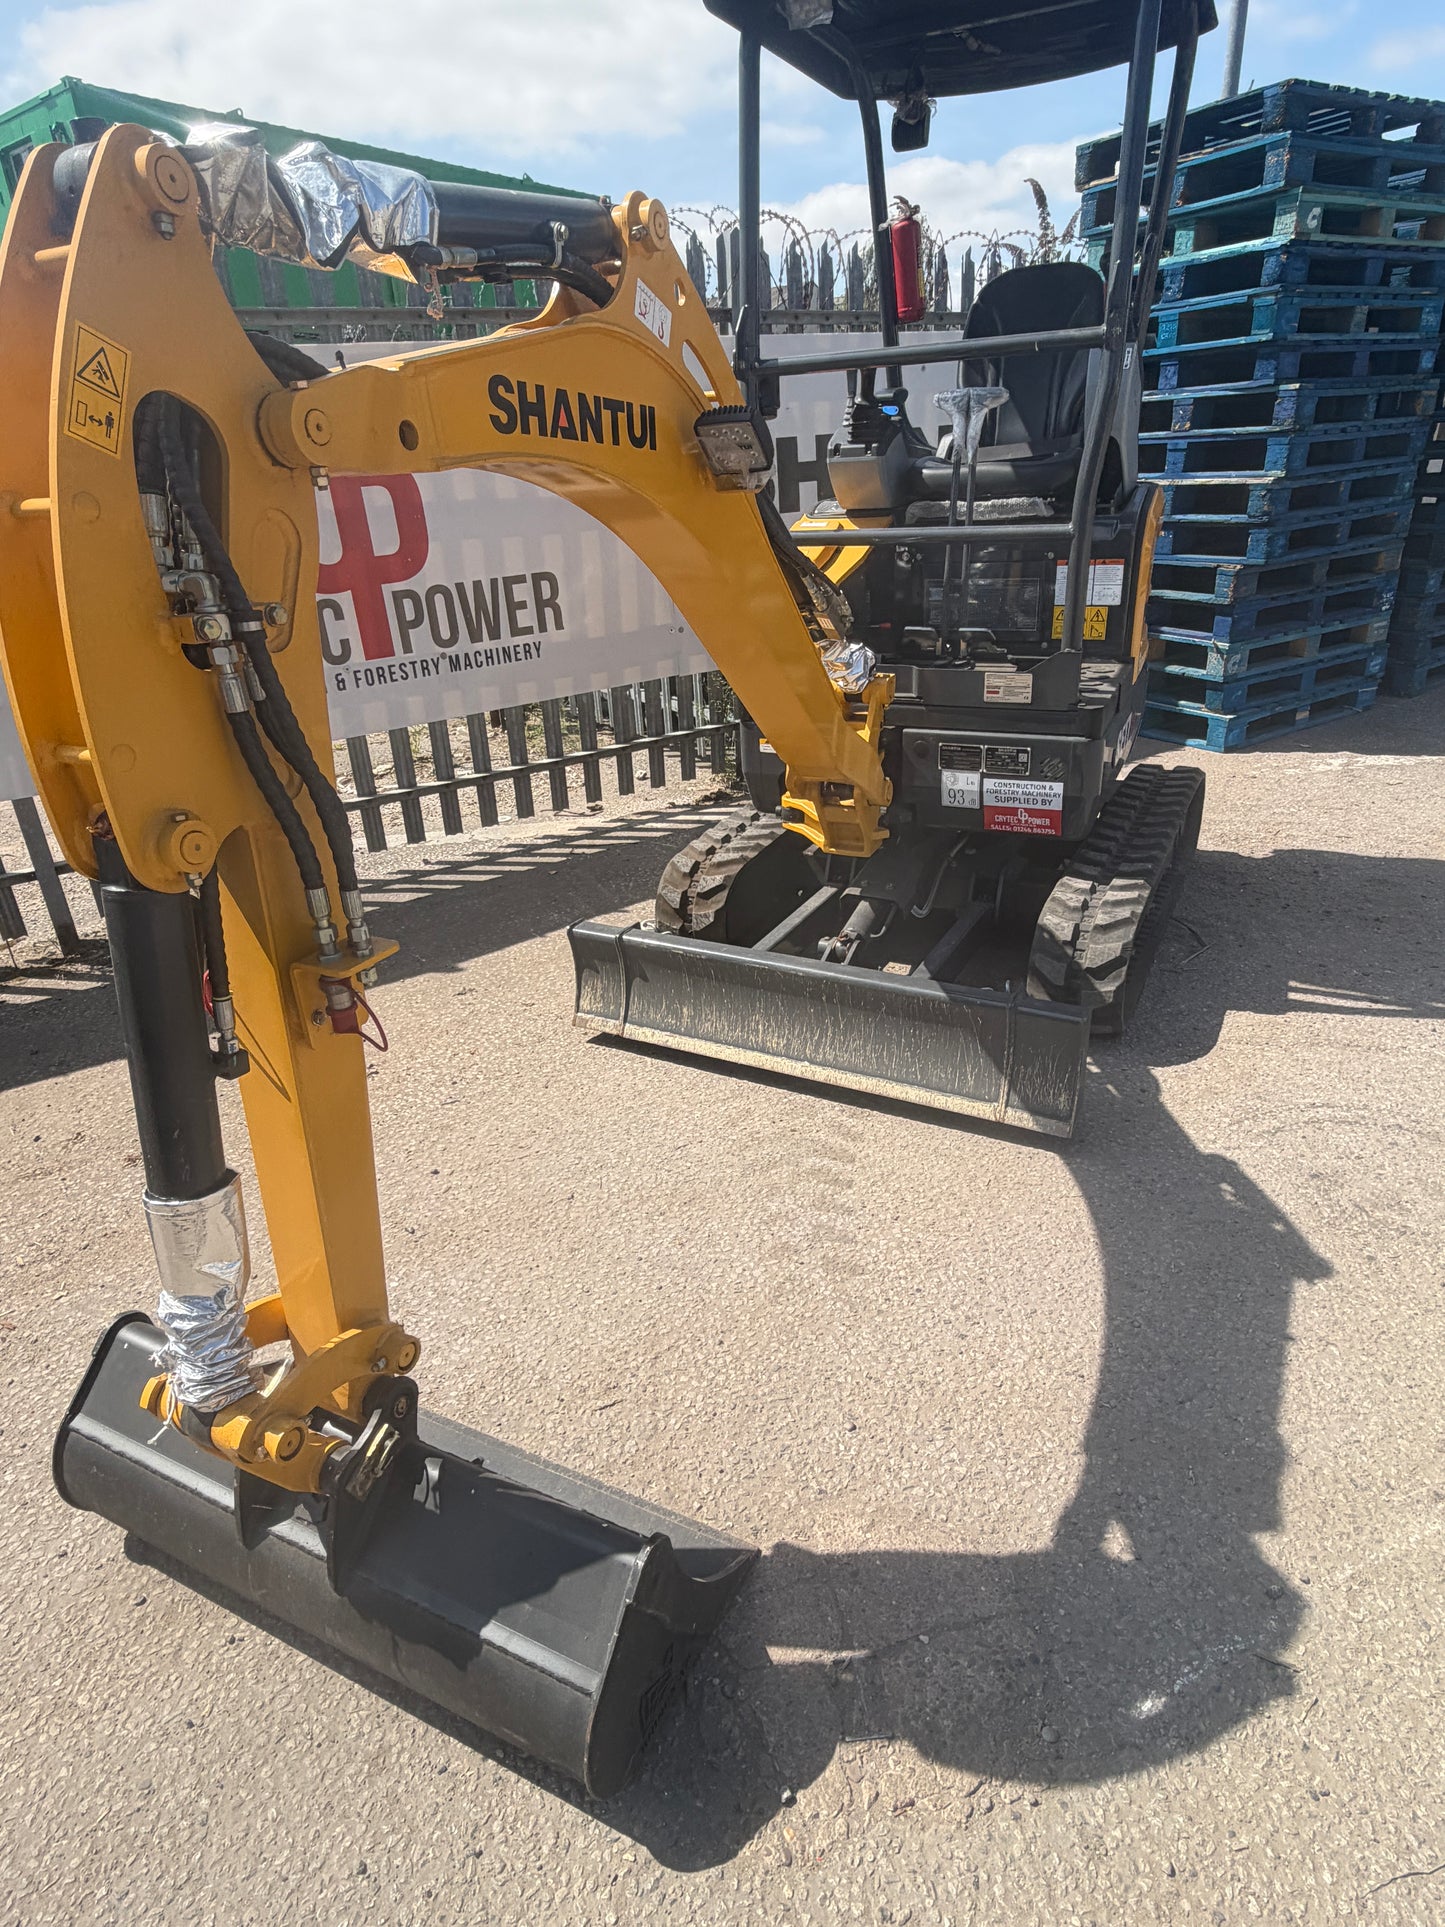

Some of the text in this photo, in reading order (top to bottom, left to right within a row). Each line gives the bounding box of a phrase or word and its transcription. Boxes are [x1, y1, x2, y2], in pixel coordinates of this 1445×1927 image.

[487, 374, 657, 451] SHANTUI
[391, 571, 565, 656] POWER
[334, 640, 542, 692] & FORESTRY MACHINERY
[993, 781, 1047, 791] CONSTRUCTION
[948, 788, 965, 805] 93
[985, 788, 1062, 799] FORESTRY MACHINERY
[994, 795, 1054, 806] SUPPLIED BY
[1027, 817, 1051, 826] POWER
